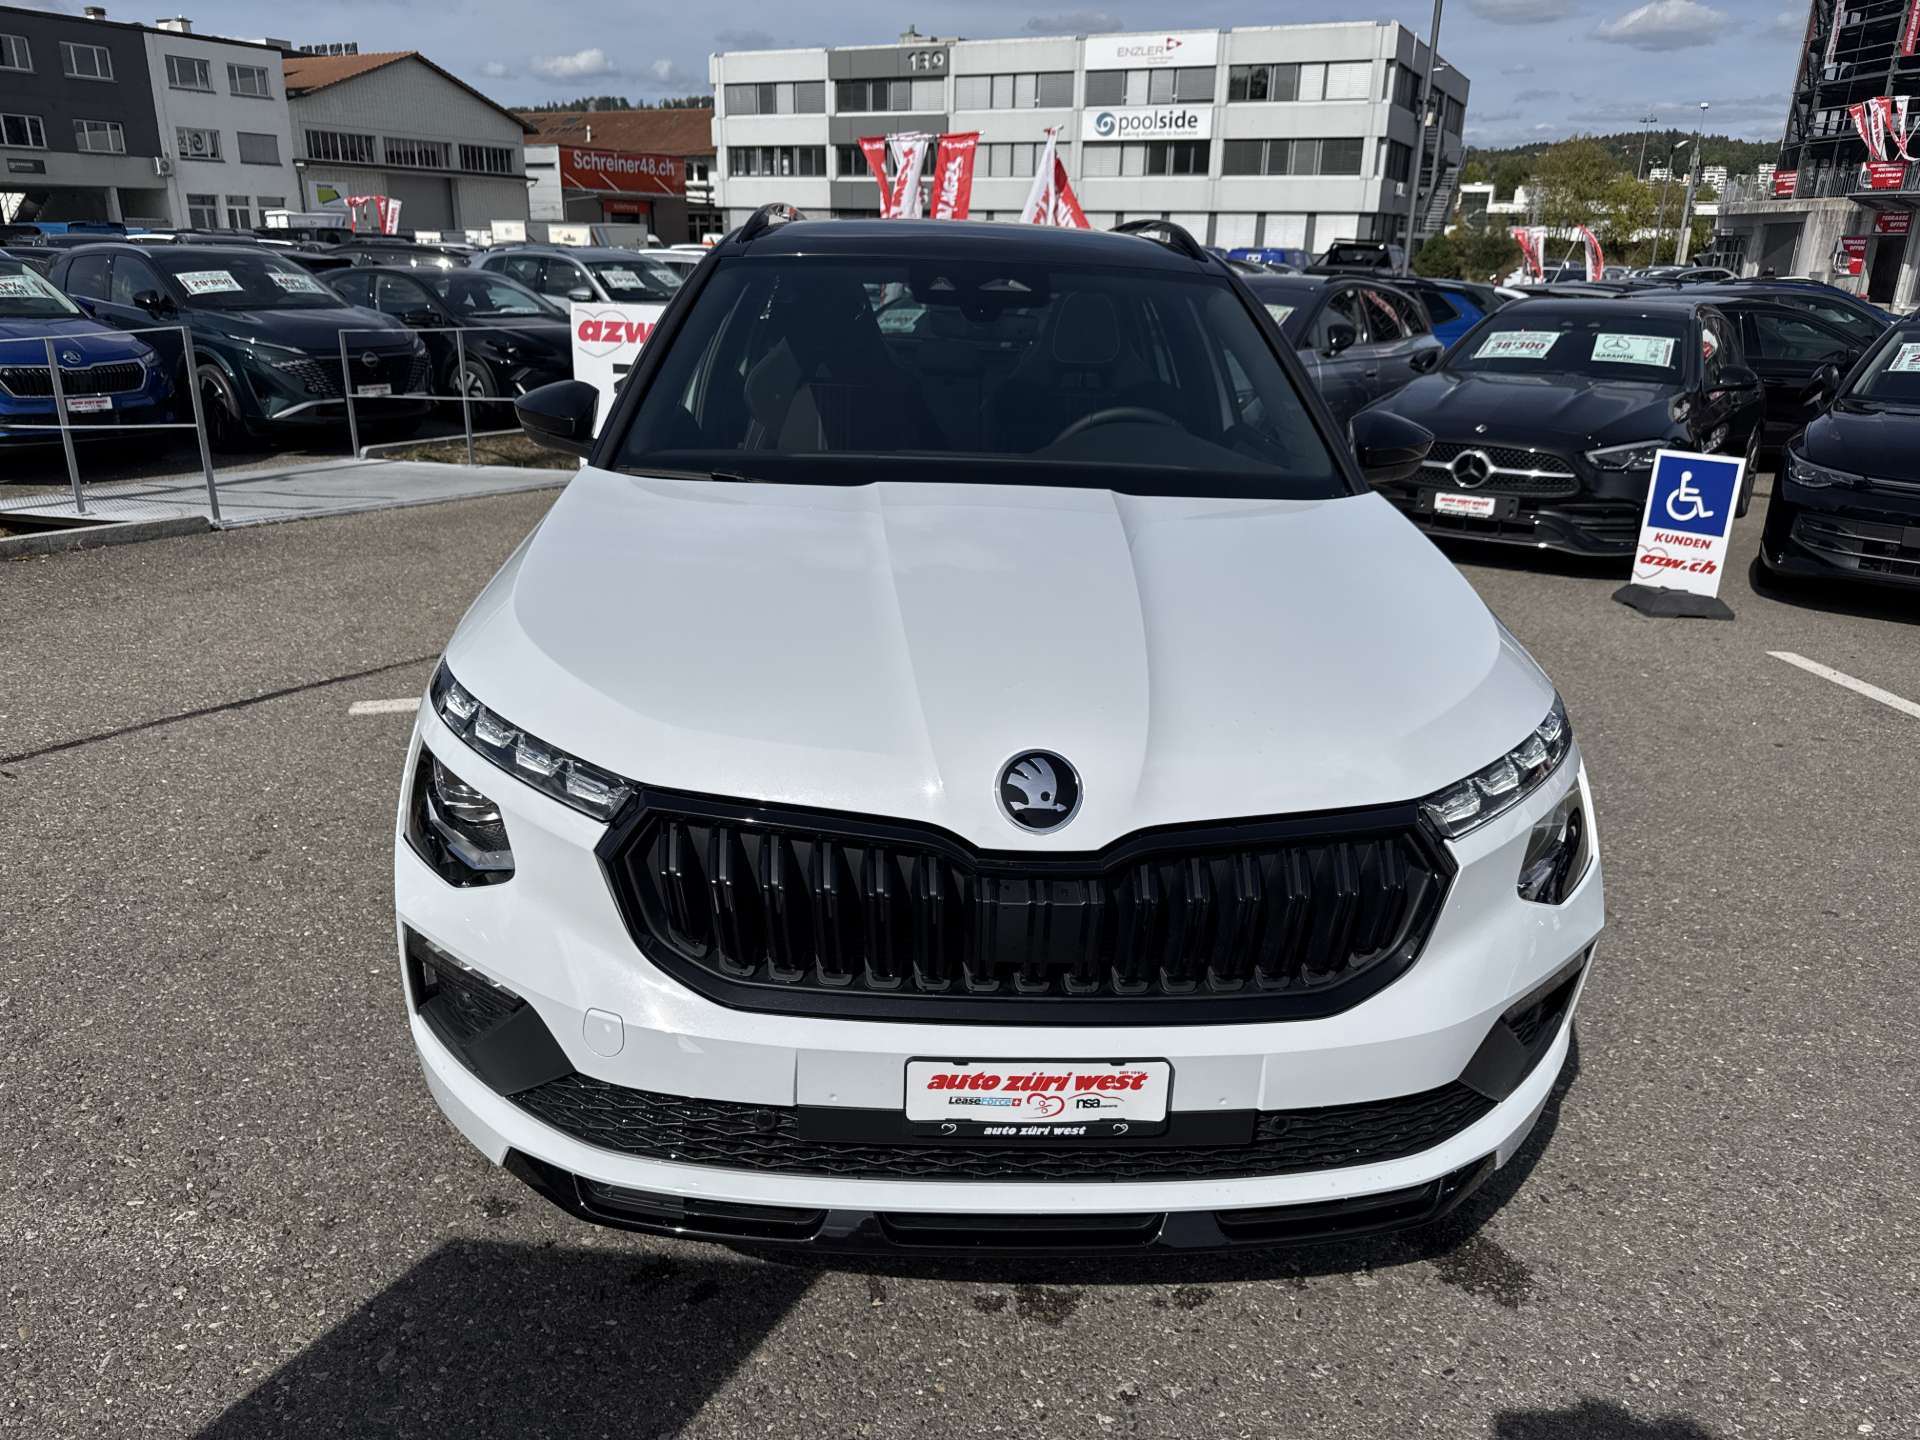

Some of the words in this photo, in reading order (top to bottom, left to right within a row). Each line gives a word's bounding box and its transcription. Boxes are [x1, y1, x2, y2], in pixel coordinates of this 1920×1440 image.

[1117, 46, 1164, 58] ENZLER
[1118, 110, 1198, 137] poolside
[573, 150, 675, 177] Schreiner48.ch
[1654, 532, 1713, 550] KUNDEN
[1639, 554, 1718, 575] azw.ch
[927, 1072, 1002, 1091] auto
[1001, 1072, 1073, 1092] züri
[1075, 1072, 1148, 1091] west
[948, 1096, 1012, 1107] LeaseForce
[1076, 1098, 1101, 1109] nsa
[984, 1126, 1017, 1135] auto
[1019, 1126, 1051, 1136] züri
[1053, 1126, 1087, 1136] west
